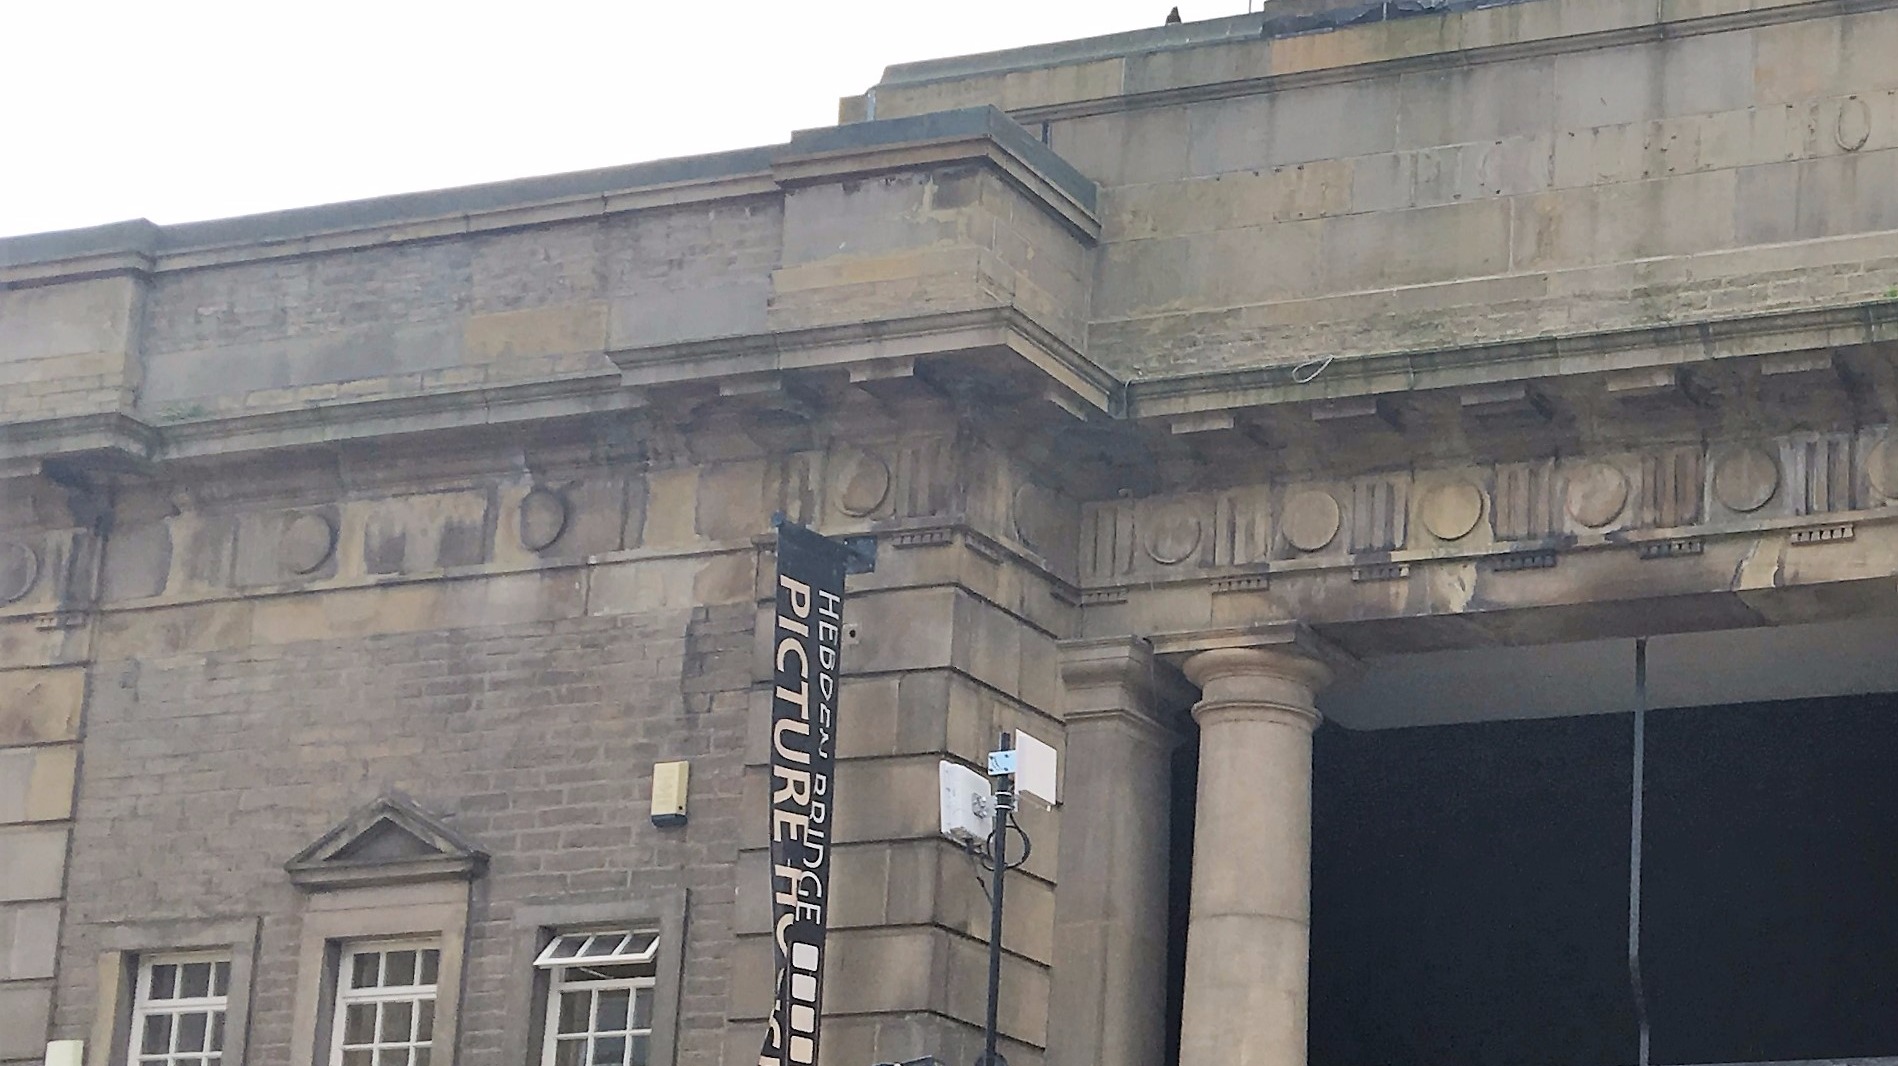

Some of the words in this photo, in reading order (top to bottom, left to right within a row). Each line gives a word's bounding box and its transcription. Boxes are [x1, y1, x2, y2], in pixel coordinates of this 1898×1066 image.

[773, 574, 811, 845] PICTURE
[818, 590, 841, 760] HEBDEN
[795, 773, 827, 925] BRIDGE
